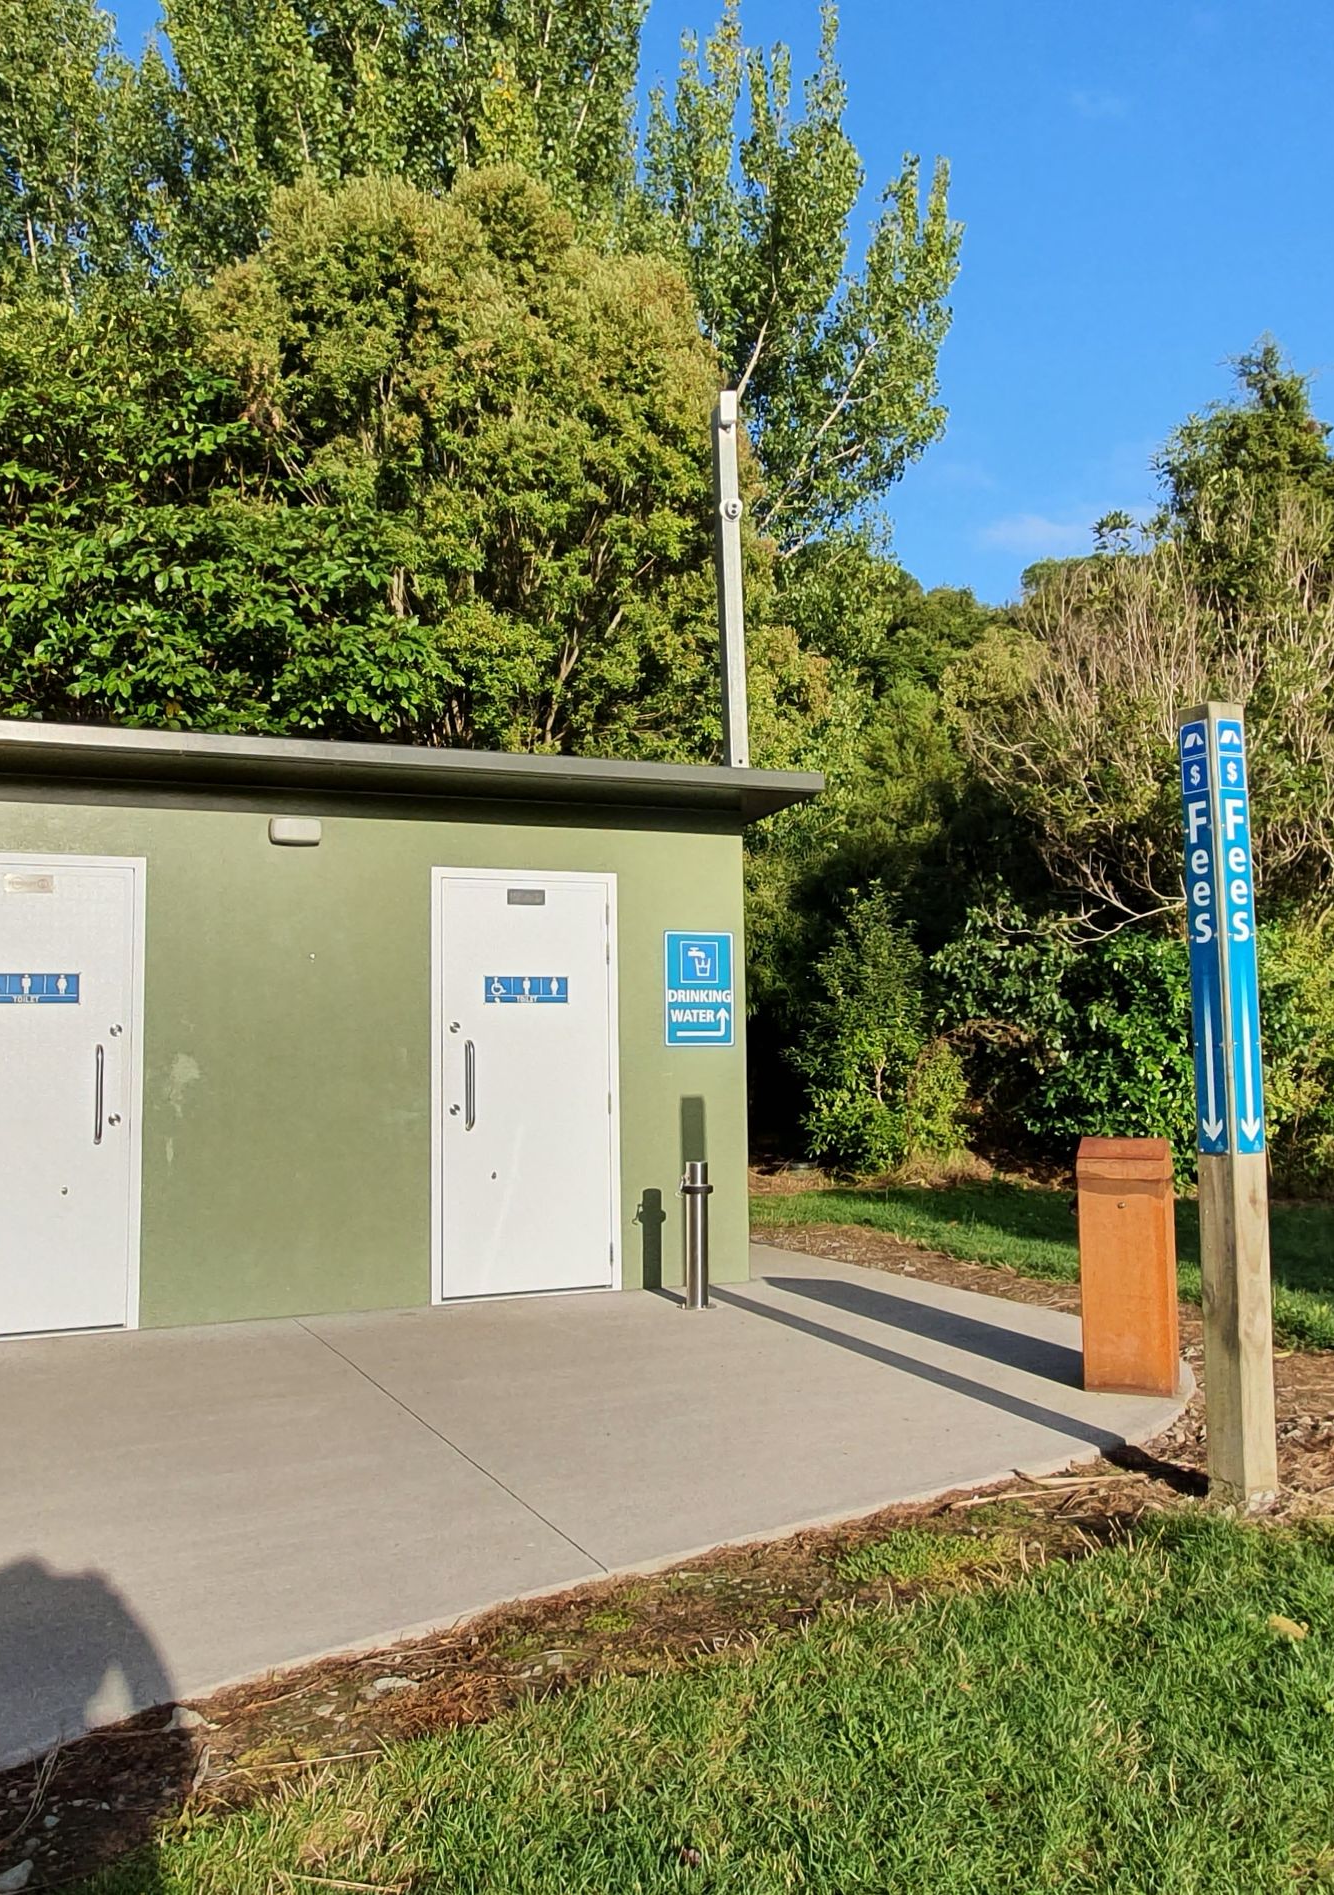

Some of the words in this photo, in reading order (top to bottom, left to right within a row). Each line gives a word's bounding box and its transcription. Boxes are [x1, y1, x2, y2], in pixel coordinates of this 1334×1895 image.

[1189, 764, 1202, 786] $
[1226, 761, 1239, 784] $
[1188, 800, 1213, 944] Fees
[1224, 798, 1250, 942] Fees
[13, 995, 40, 1003] TOILET
[668, 989, 731, 1003] DRINKING
[670, 1009, 715, 1023] WATER
